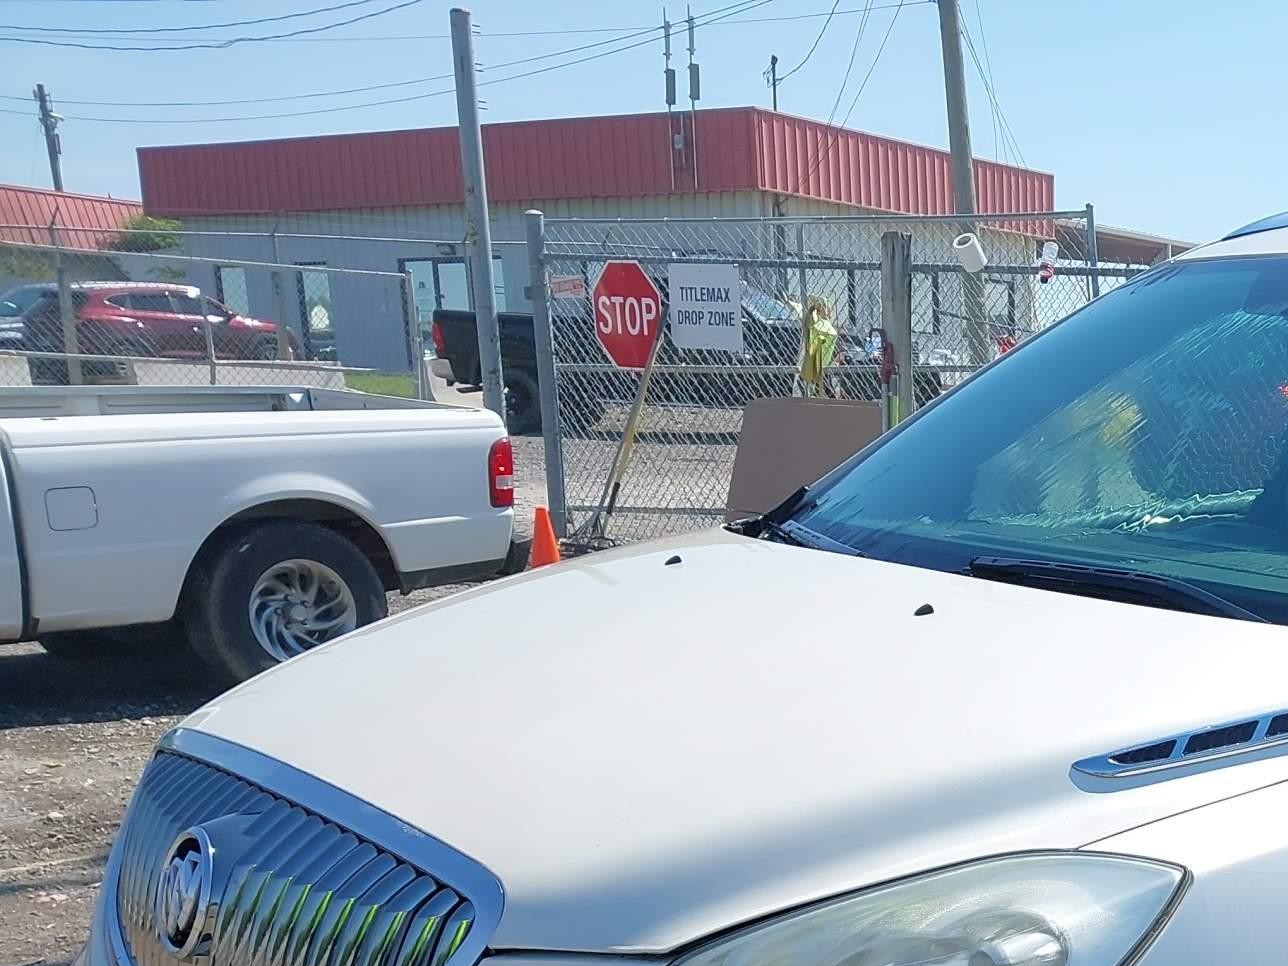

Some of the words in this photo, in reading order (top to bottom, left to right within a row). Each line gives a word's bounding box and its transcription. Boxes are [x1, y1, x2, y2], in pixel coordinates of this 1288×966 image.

[679, 286, 730, 303] TITLEMAX
[598, 295, 657, 336] STOP
[677, 310, 704, 326] DROP
[707, 311, 736, 327] ZONE
